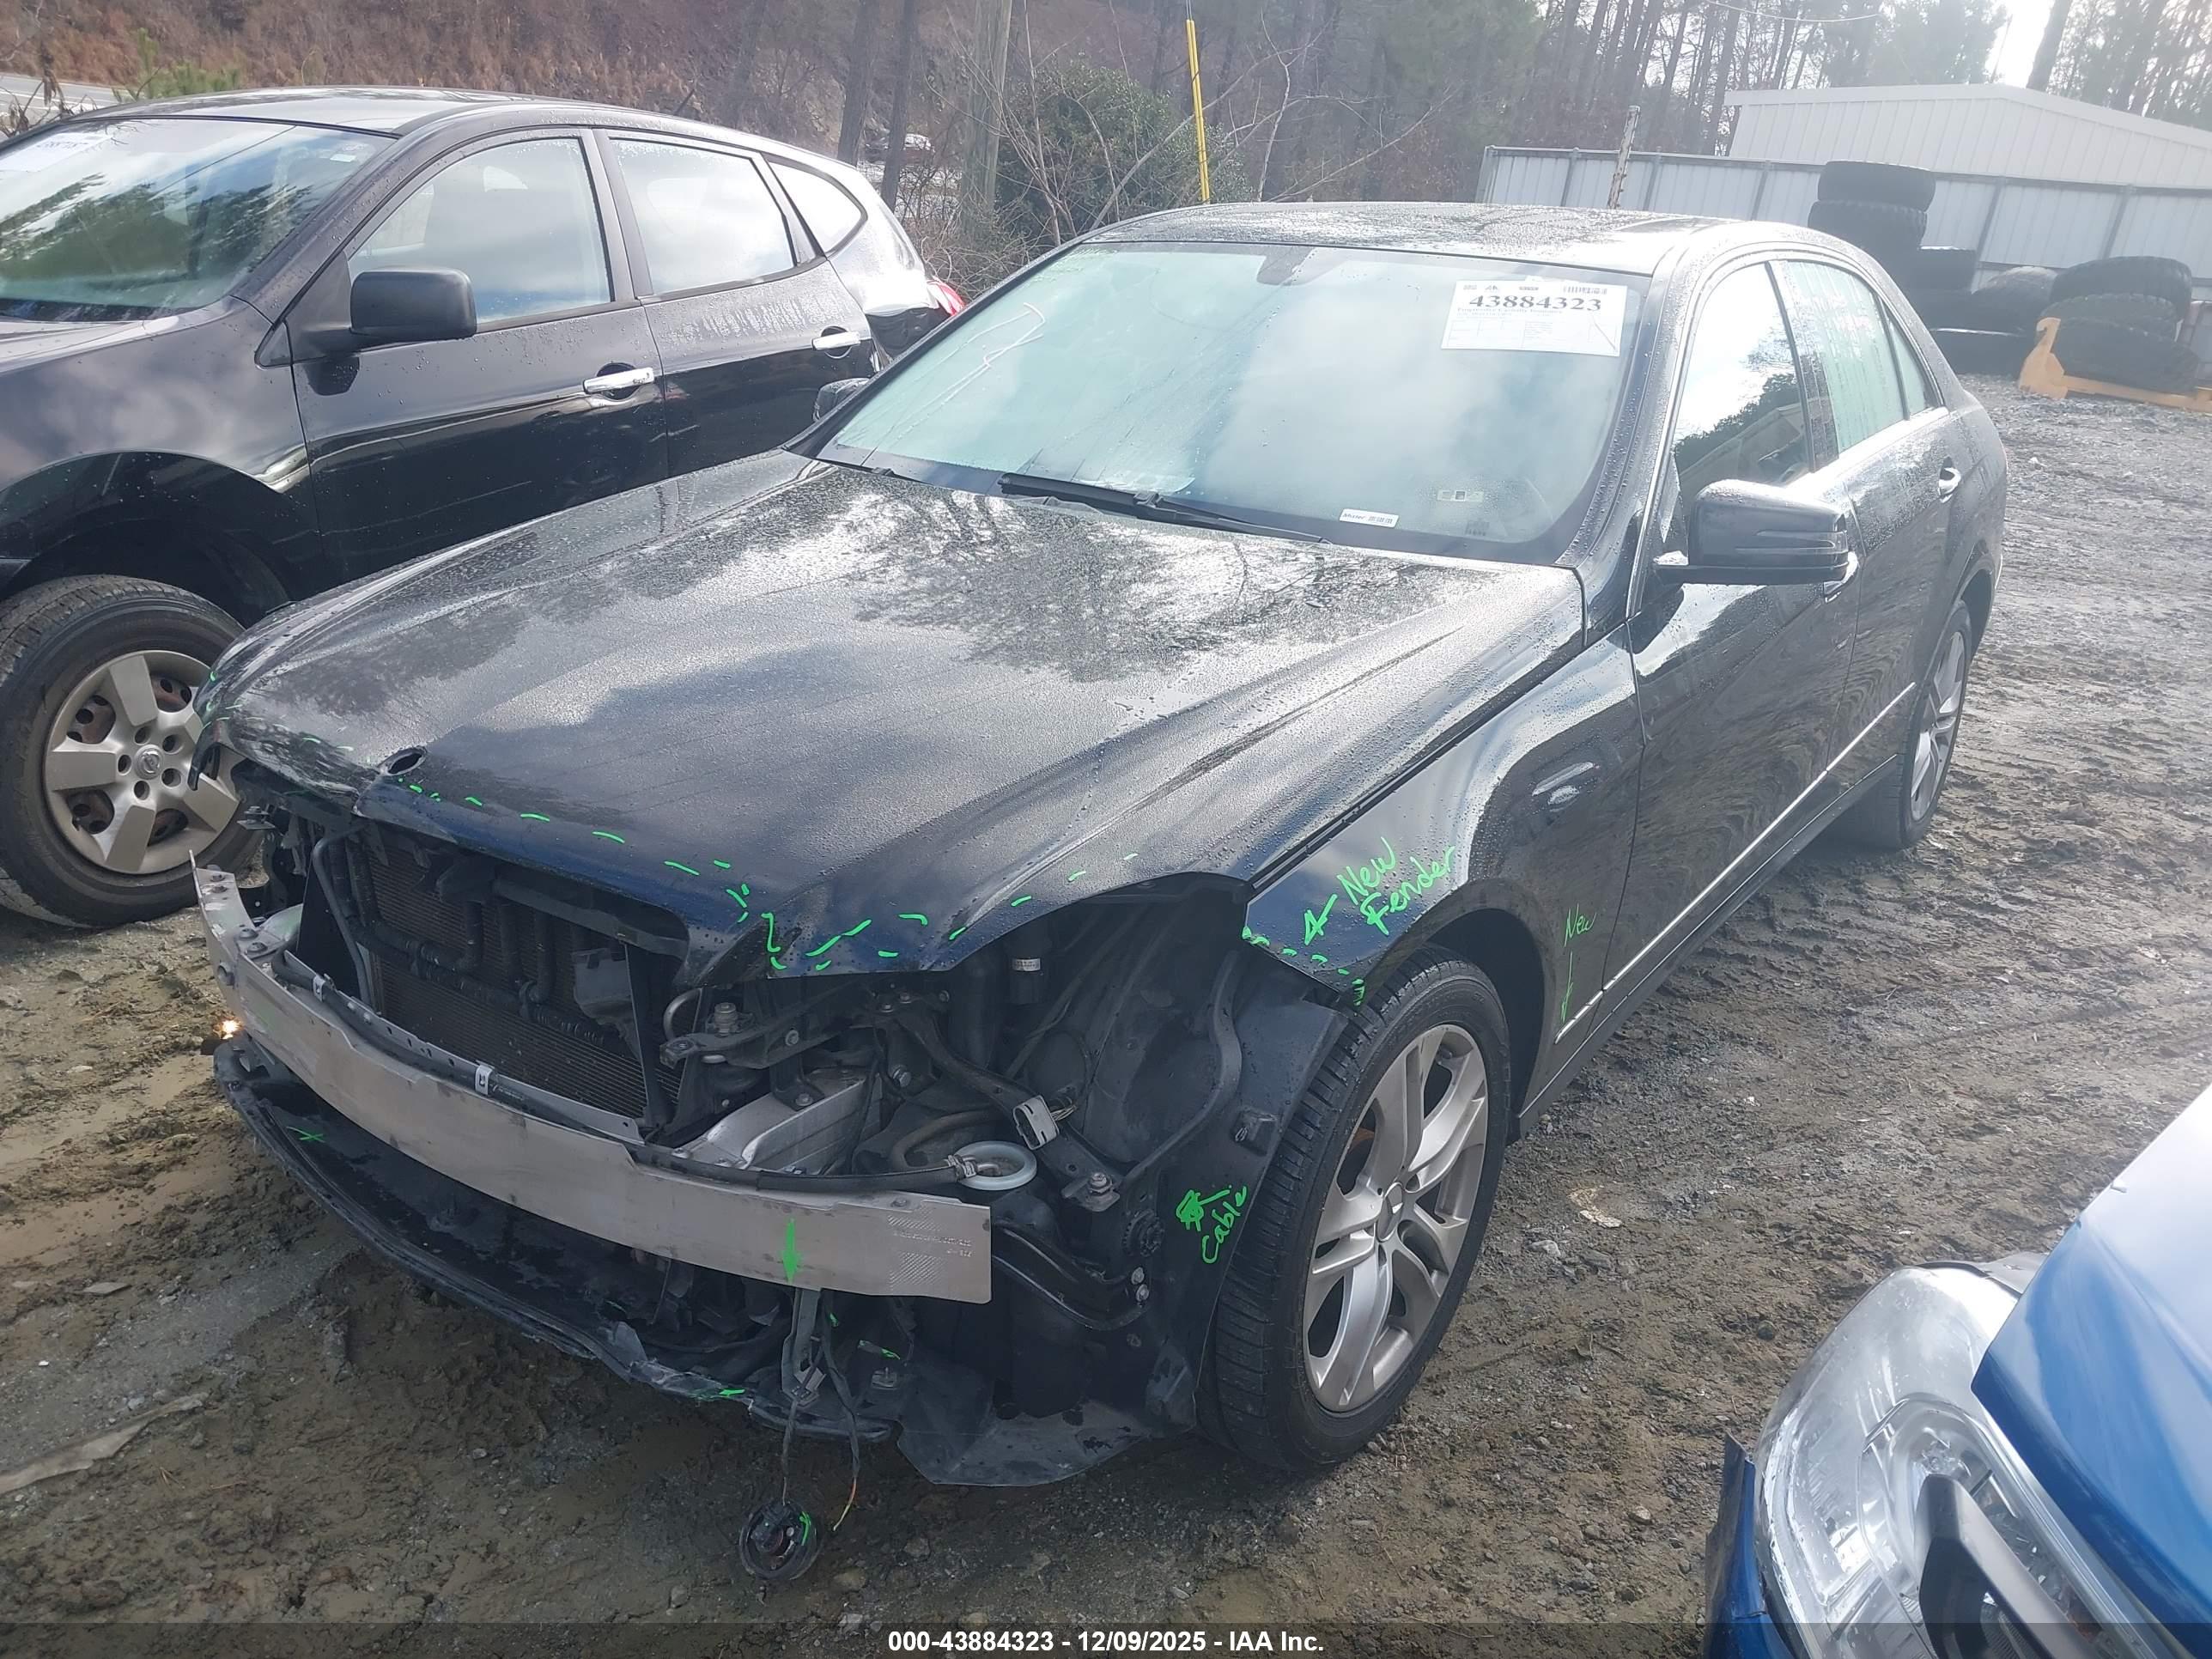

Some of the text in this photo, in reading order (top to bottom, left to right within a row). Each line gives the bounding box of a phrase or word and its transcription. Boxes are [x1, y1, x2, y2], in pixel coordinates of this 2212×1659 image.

[1469, 295, 1601, 311] 43884323
[1336, 836, 1397, 905] New
[1359, 846, 1455, 936] Fender
